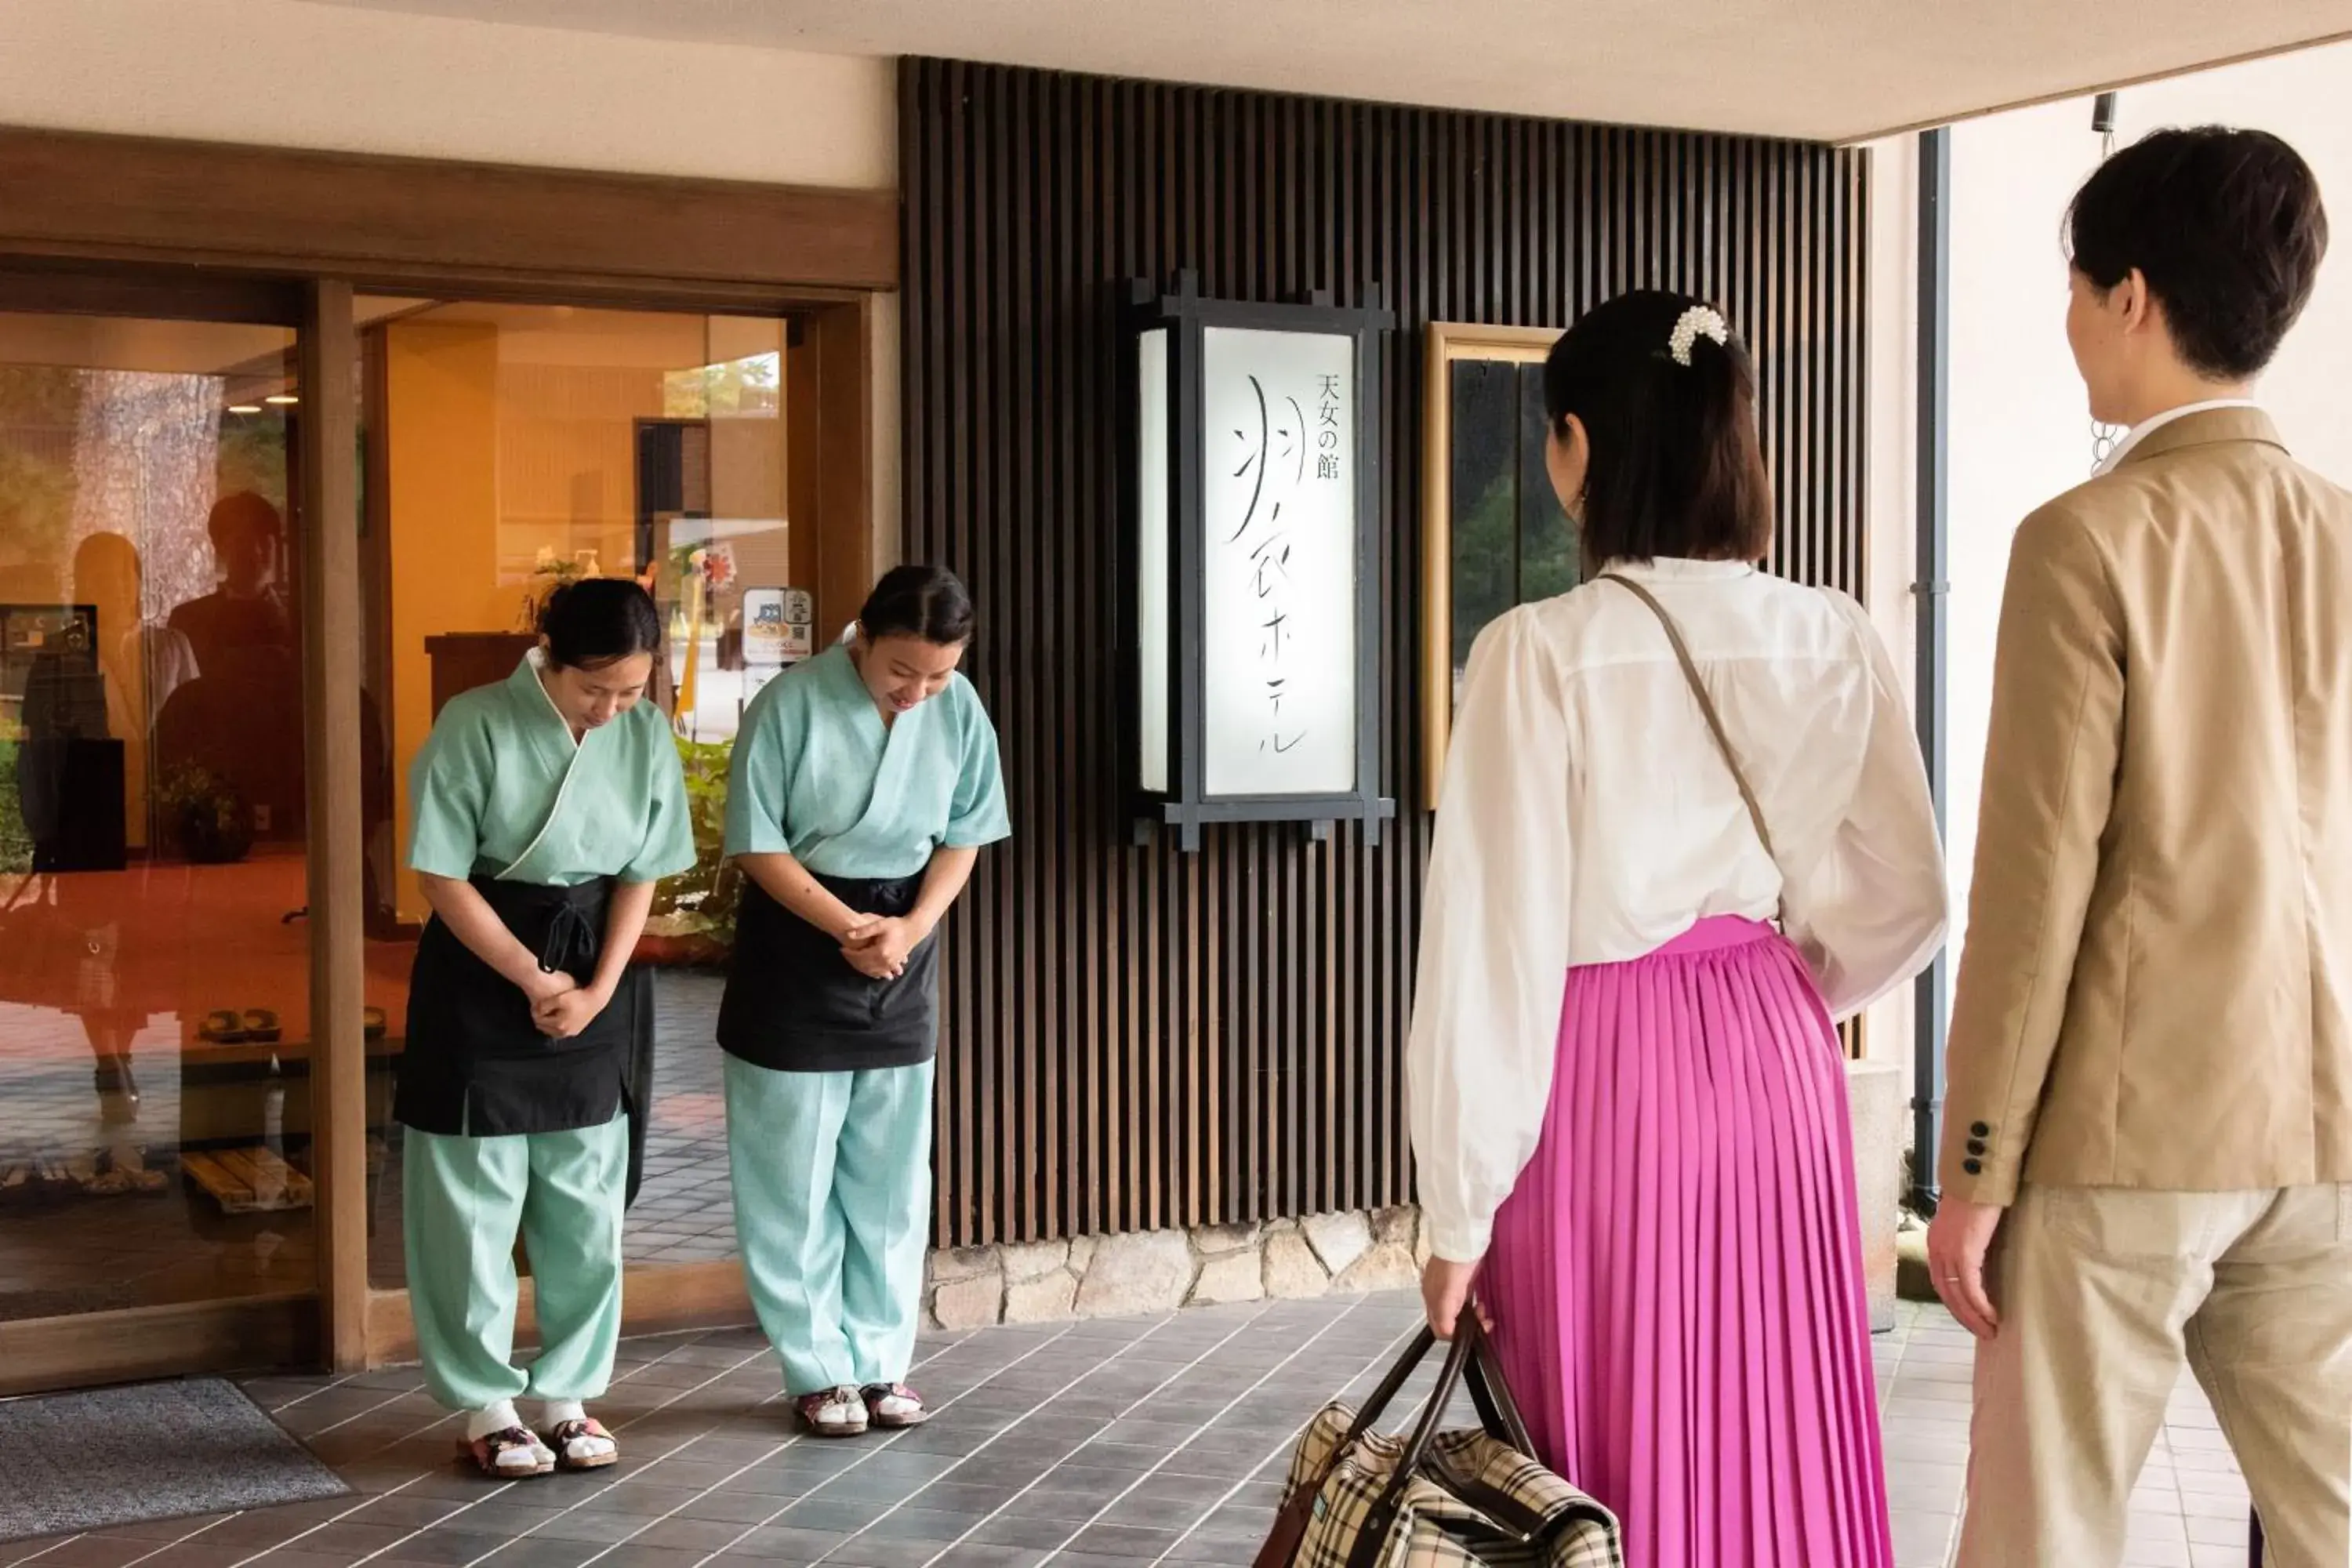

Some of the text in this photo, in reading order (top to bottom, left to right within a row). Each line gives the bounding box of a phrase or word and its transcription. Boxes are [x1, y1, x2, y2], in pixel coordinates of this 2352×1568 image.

[1316, 374, 1340, 480] 天女の館
[1221, 374, 1306, 753] 羽衣ホテル
